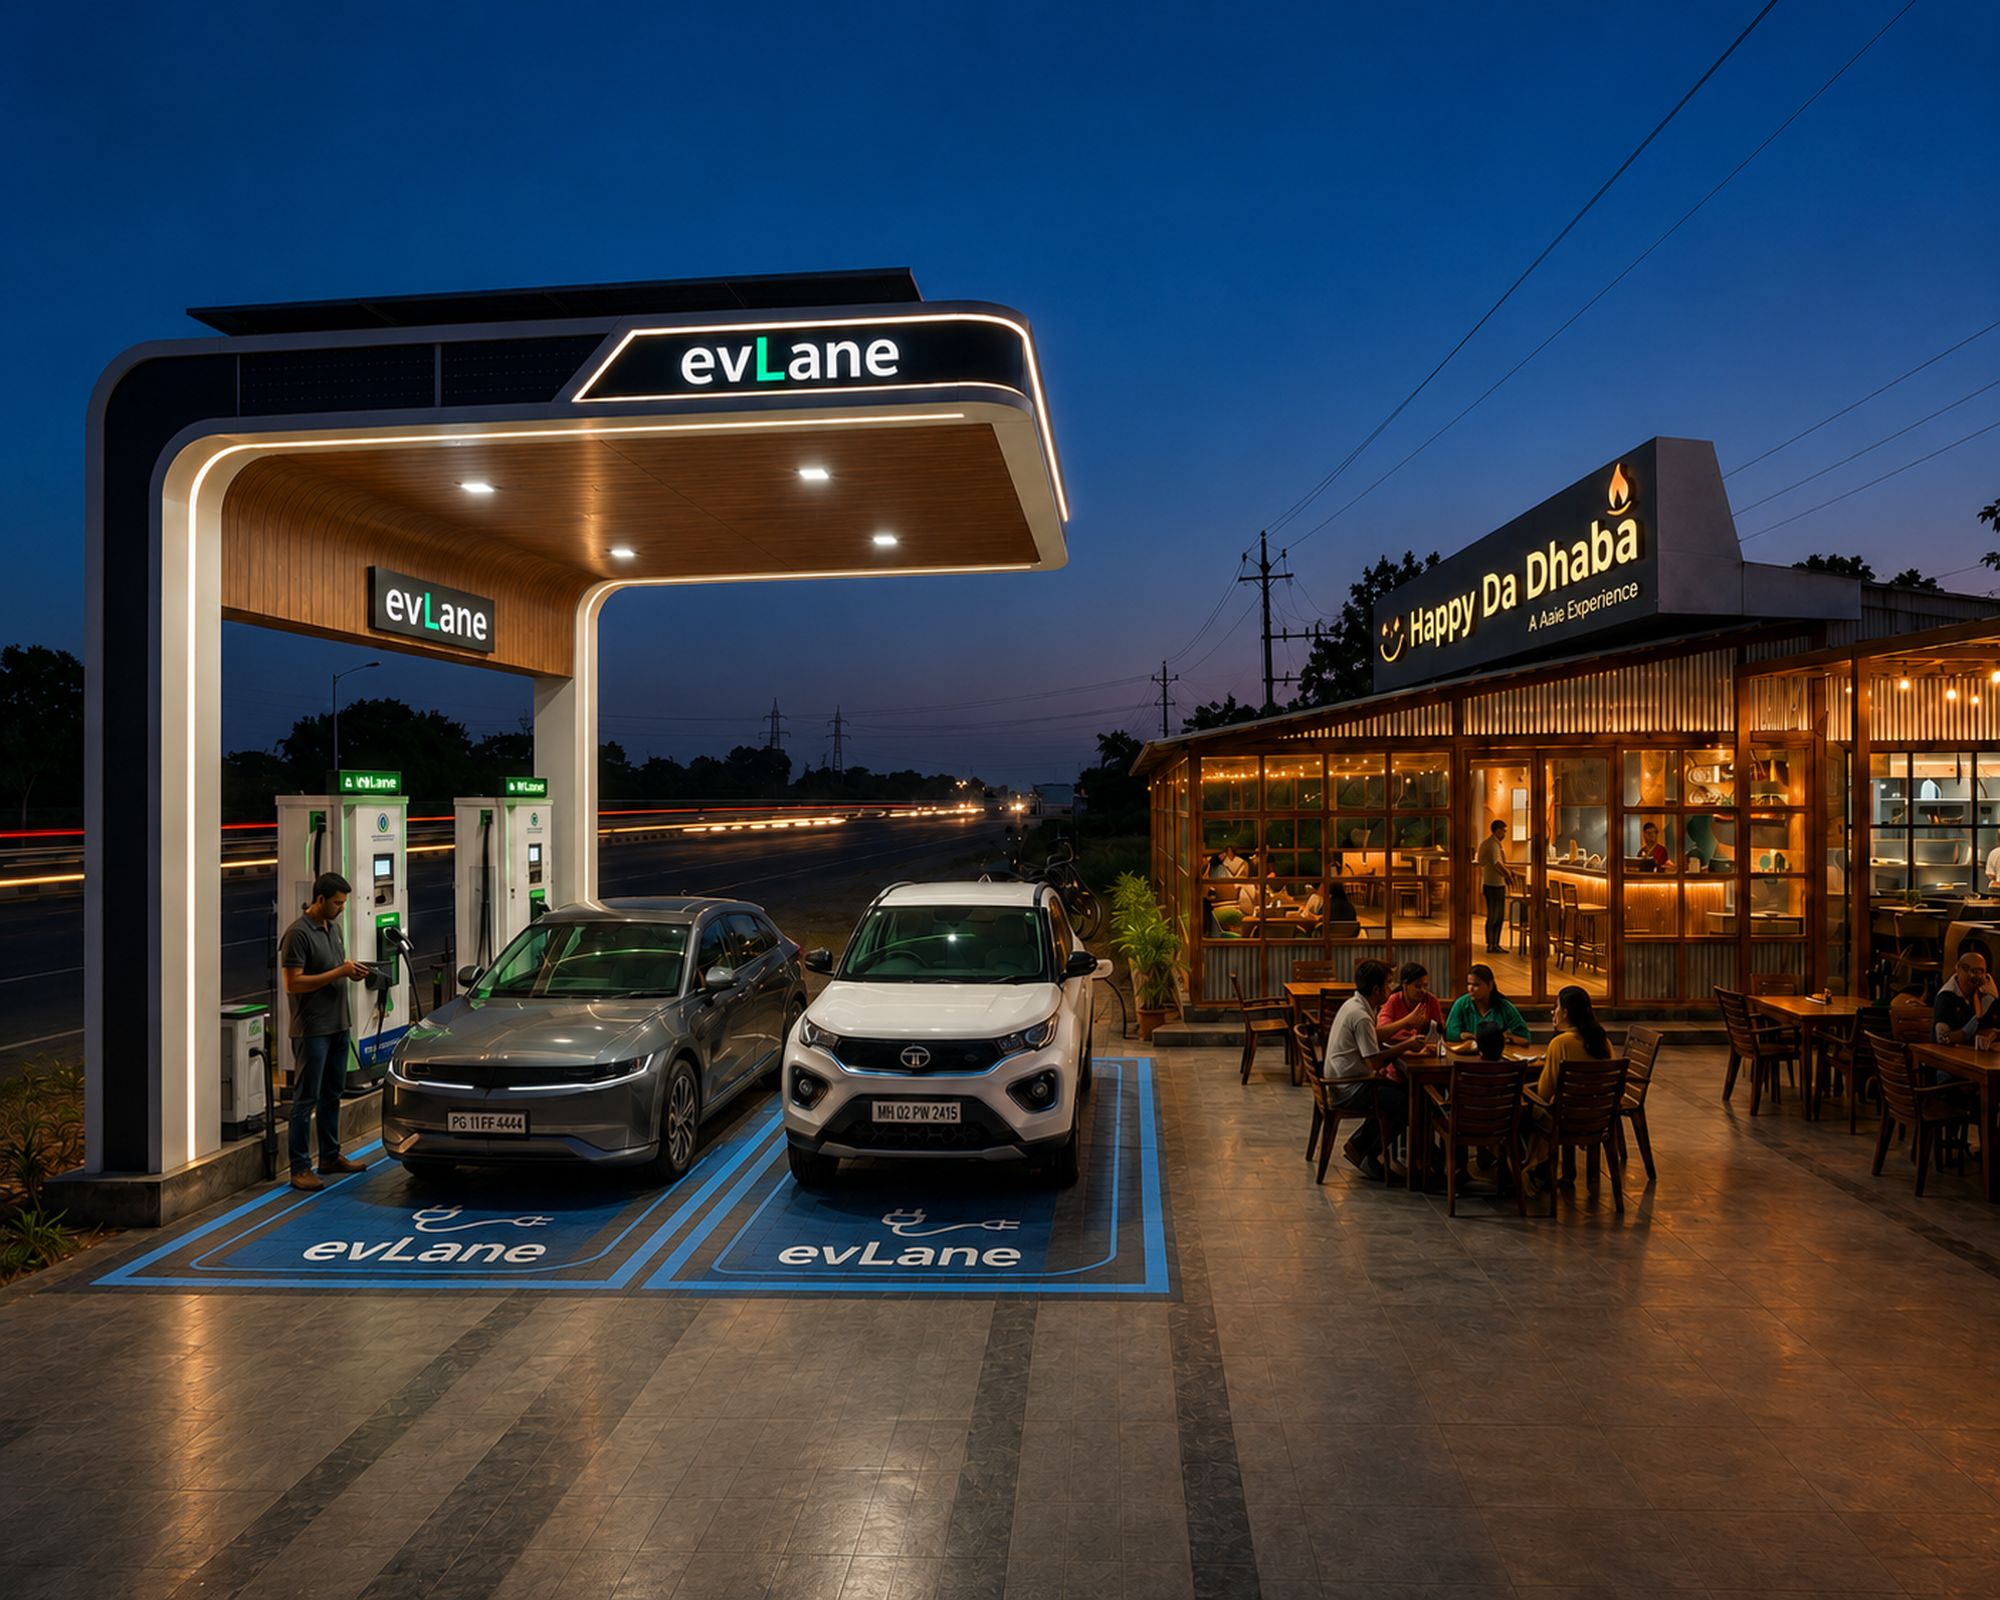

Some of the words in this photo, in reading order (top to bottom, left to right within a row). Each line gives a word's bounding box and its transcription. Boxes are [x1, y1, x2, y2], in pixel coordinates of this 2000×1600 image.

[681, 336, 899, 385] evLane
[1410, 590, 1476, 648] Happy
[1482, 572, 1517, 618] Da
[1526, 518, 1638, 600] Dhaba
[1528, 614, 1538, 632] A
[1567, 581, 1639, 620] Experience
[385, 588, 488, 641] evLane
[877, 1105, 895, 1120] MH
[896, 1105, 911, 1120] 02
[302, 1236, 547, 1263] evLane
[778, 1241, 1021, 1267] evLane
